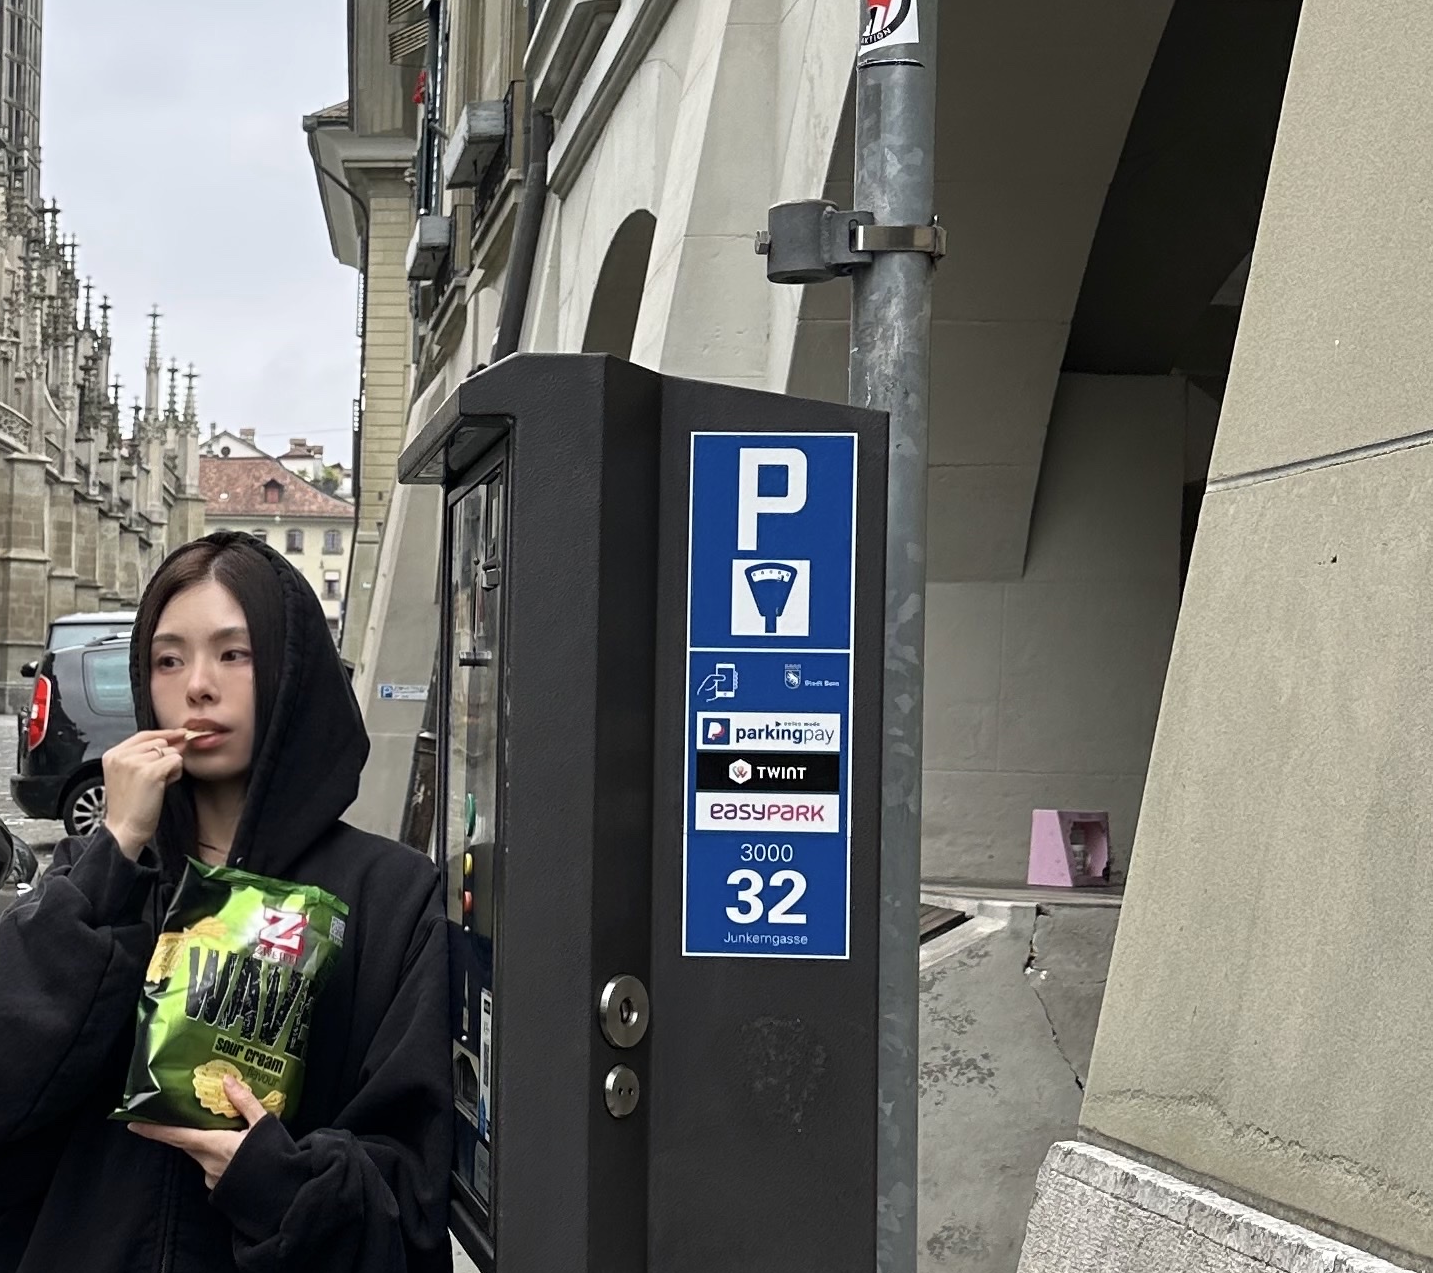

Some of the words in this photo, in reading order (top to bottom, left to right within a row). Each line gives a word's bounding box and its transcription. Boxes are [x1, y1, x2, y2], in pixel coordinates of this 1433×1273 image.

[737, 447, 808, 551] P
[736, 724, 835, 745] parkingpay
[756, 766, 807, 779] TWINT
[740, 843, 794, 862] 3000
[725, 868, 807, 924] 32
[214, 1037, 244, 1057] sour
[243, 1047, 284, 1074] cream
